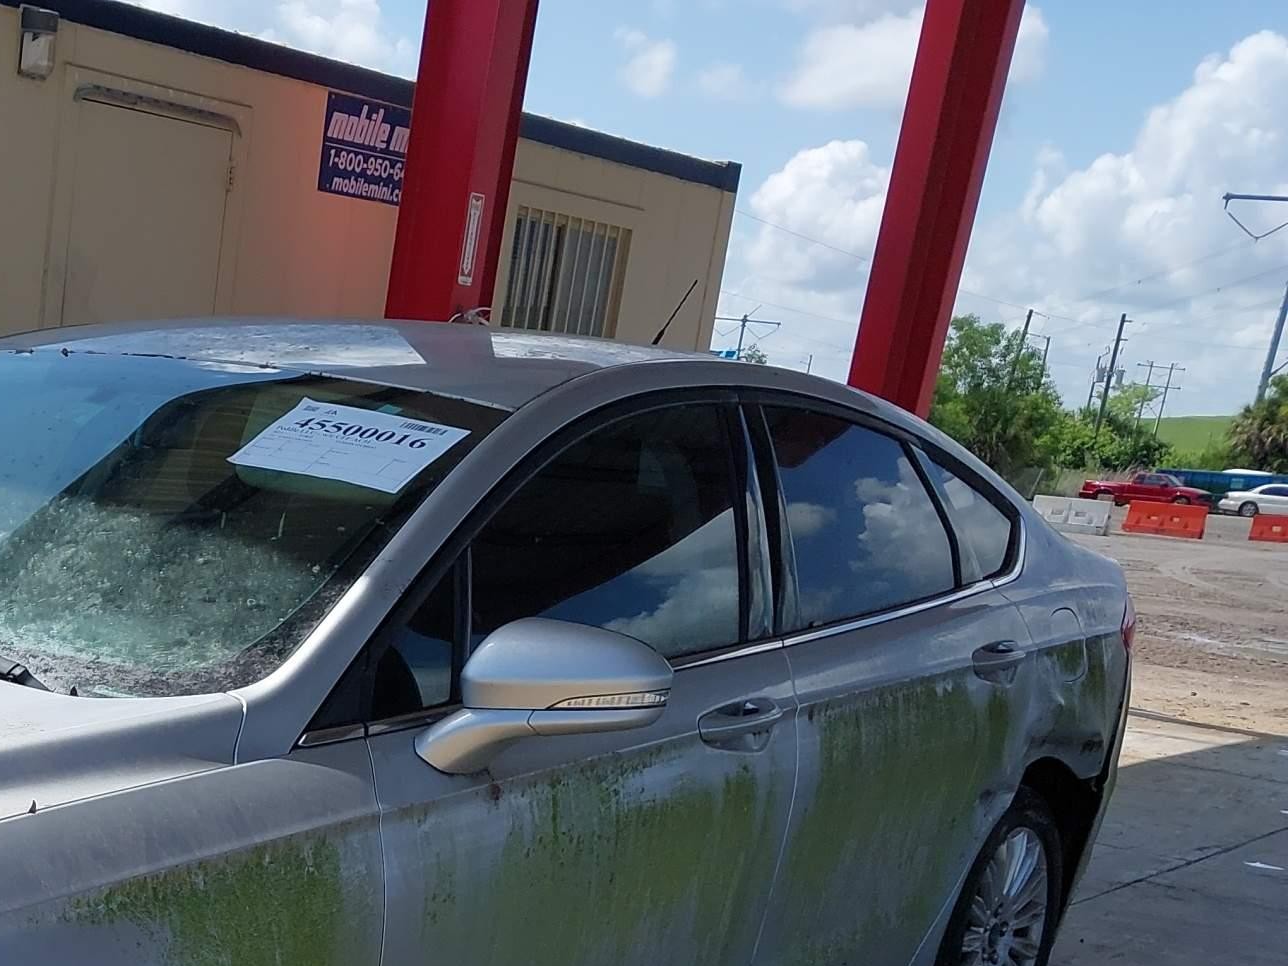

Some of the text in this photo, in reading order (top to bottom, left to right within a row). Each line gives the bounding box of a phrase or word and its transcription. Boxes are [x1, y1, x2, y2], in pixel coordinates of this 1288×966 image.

[327, 105, 411, 153] mobile m
[294, 417, 434, 449] 45500016
